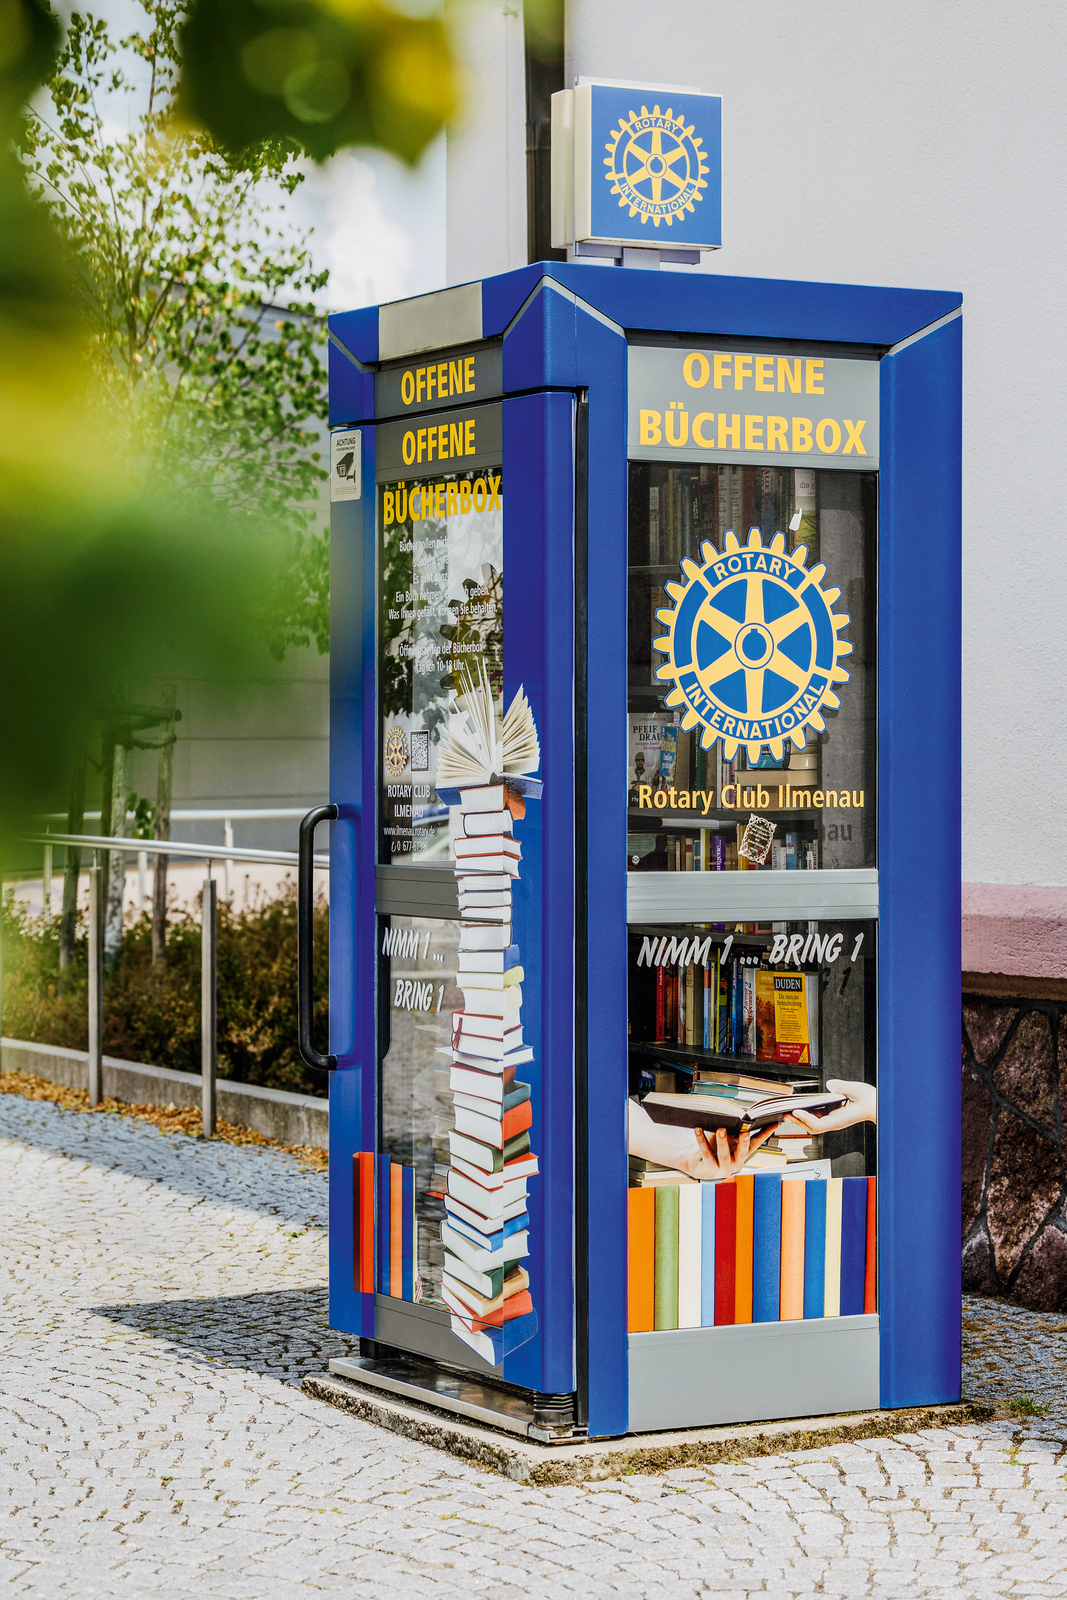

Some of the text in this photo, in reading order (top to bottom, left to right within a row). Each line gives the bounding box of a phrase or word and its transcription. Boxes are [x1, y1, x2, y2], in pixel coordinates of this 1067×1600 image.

[634, 117, 679, 133] ROTARY
[620, 182, 695, 214] INTERNATIONAL
[401, 356, 476, 405] OFFENE
[683, 352, 825, 395] OFFENE
[336, 437, 356, 447] ACHTUNG
[402, 419, 476, 465] OFFENE
[639, 401, 867, 455] BÜCHERBOX
[383, 475, 502, 525] BÜCHERBOX
[400, 539, 418, 552] Bücher
[713, 553, 797, 581] ROTARY
[396, 591, 404, 602] Ein
[405, 590, 418, 602] Buch
[388, 608, 400, 620] Was
[401, 607, 416, 619] Ihnen
[461, 603, 469, 615] Sie
[470, 601, 498, 614] behalten.
[454, 659, 465, 671] Uhr.
[684, 682, 825, 739] INTERNATIONAL
[633, 725, 658, 733] PFEIF
[639, 733, 662, 741] DRAU
[387, 784, 431, 798] ROTARY CLUB
[638, 783, 865, 816] Rotary Club Ilmenau
[394, 804, 424, 818] ILMENAU
[382, 926, 420, 960] NIMM
[423, 931, 431, 960] 1
[637, 935, 713, 967] NIMM
[719, 935, 734, 965] 1
[768, 933, 843, 965] BRING
[850, 932, 865, 962] 1
[394, 979, 445, 1013] BRING 1
[775, 978, 801, 990] DUDEN
